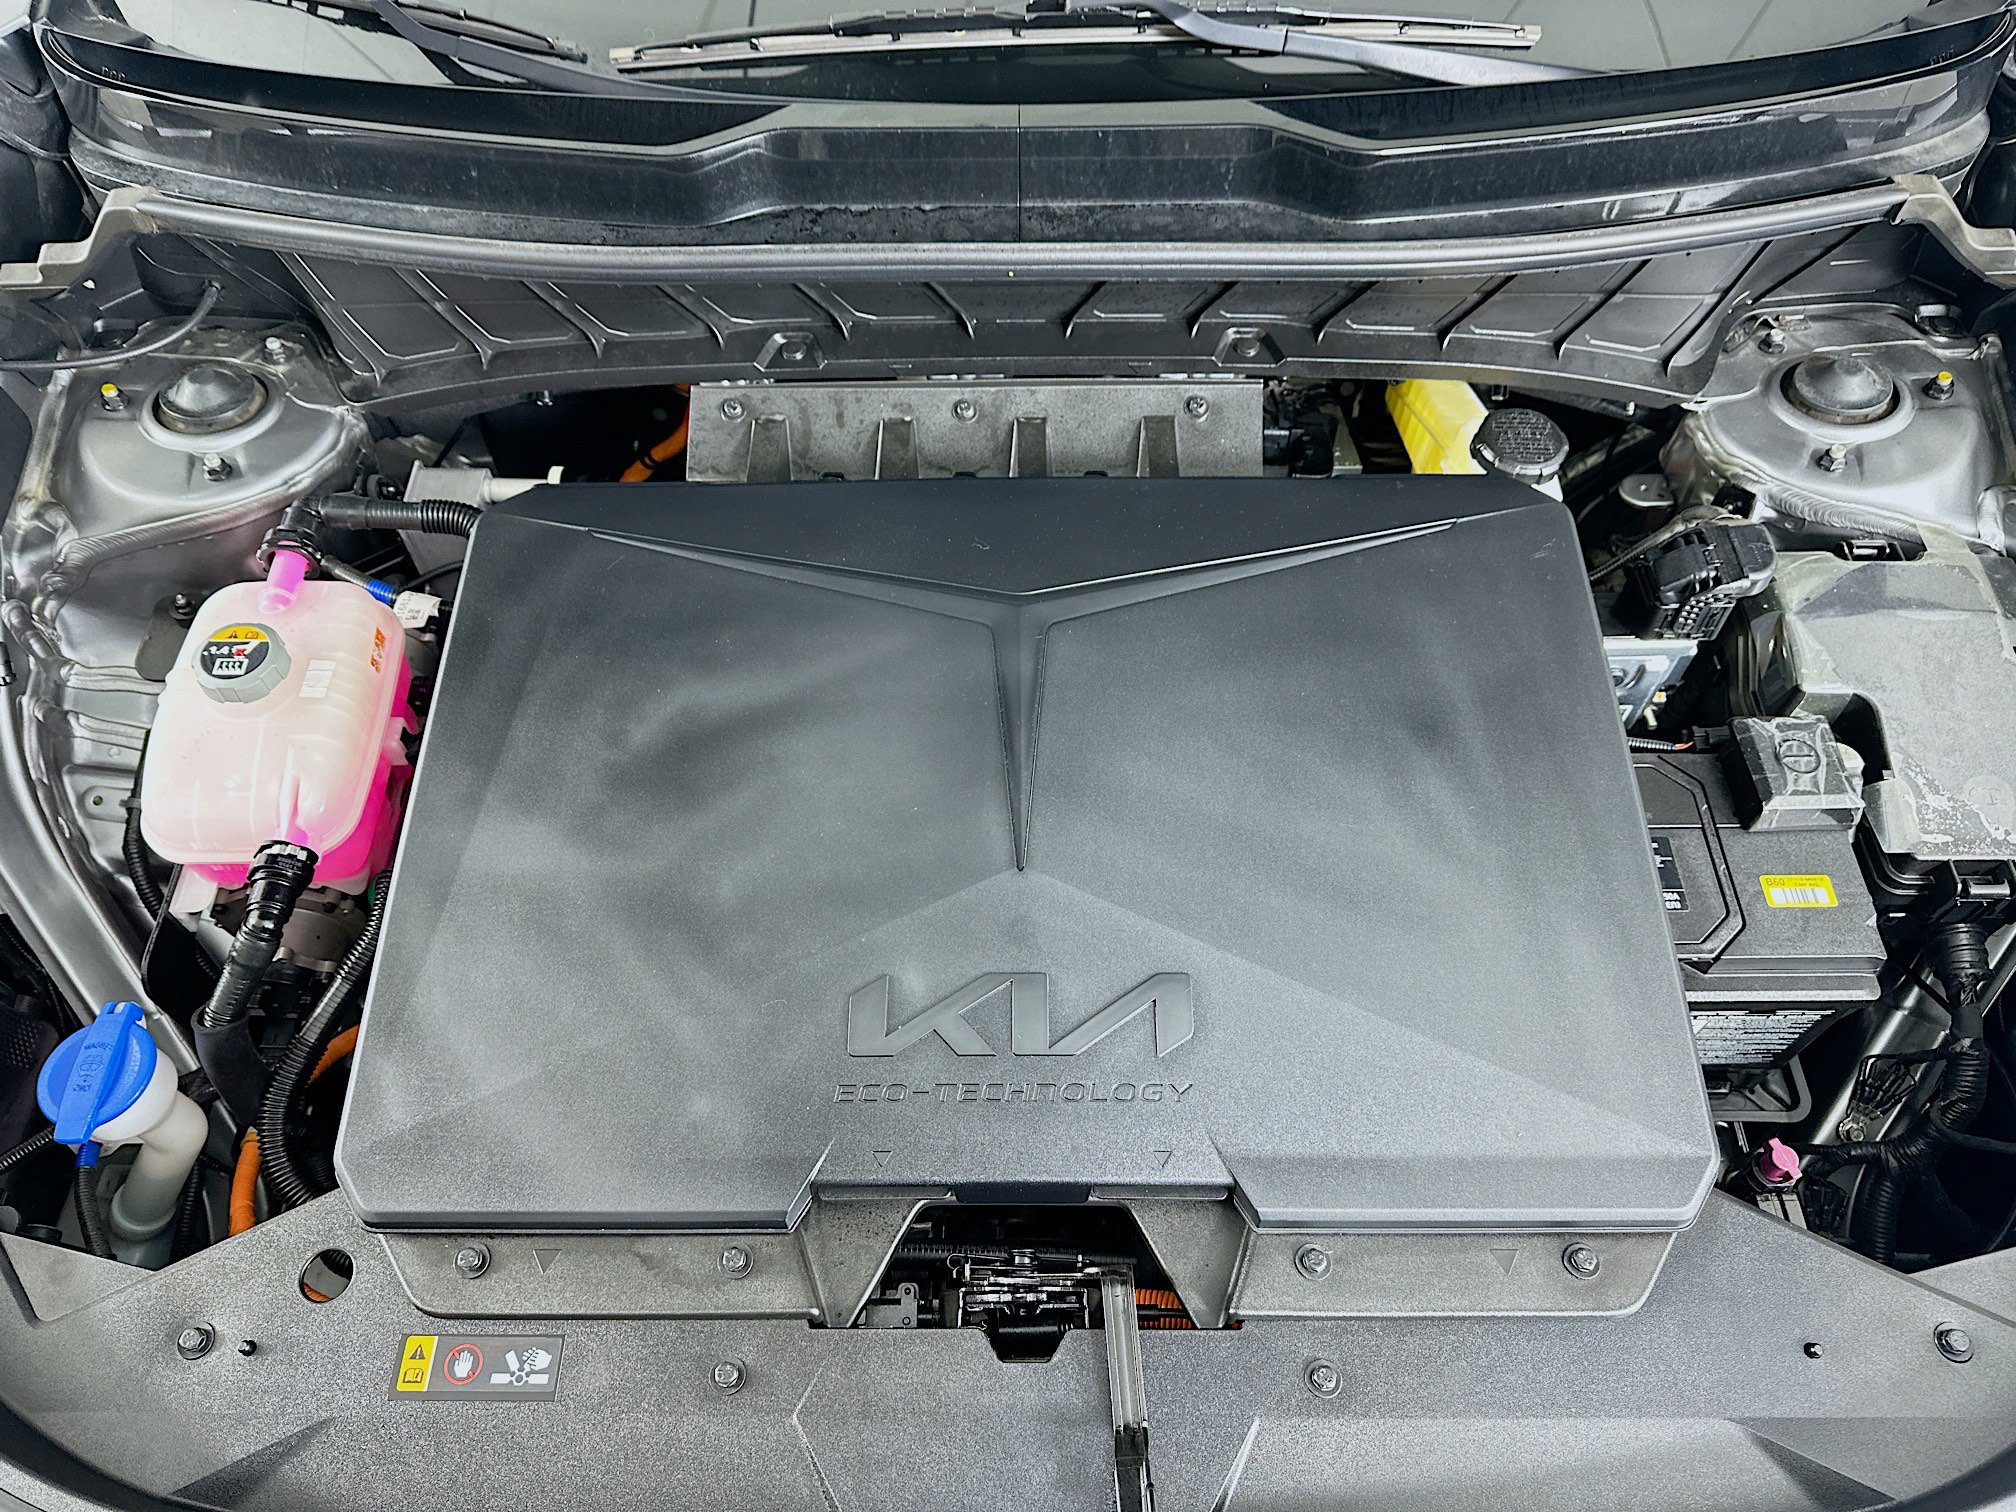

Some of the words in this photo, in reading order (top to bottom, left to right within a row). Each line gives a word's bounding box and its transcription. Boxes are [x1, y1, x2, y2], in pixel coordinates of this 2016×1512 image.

[1765, 877, 1785, 886] B60
[847, 972, 1195, 1058] KIA
[833, 1082, 1194, 1104] ECO-TECHNOLOGY
